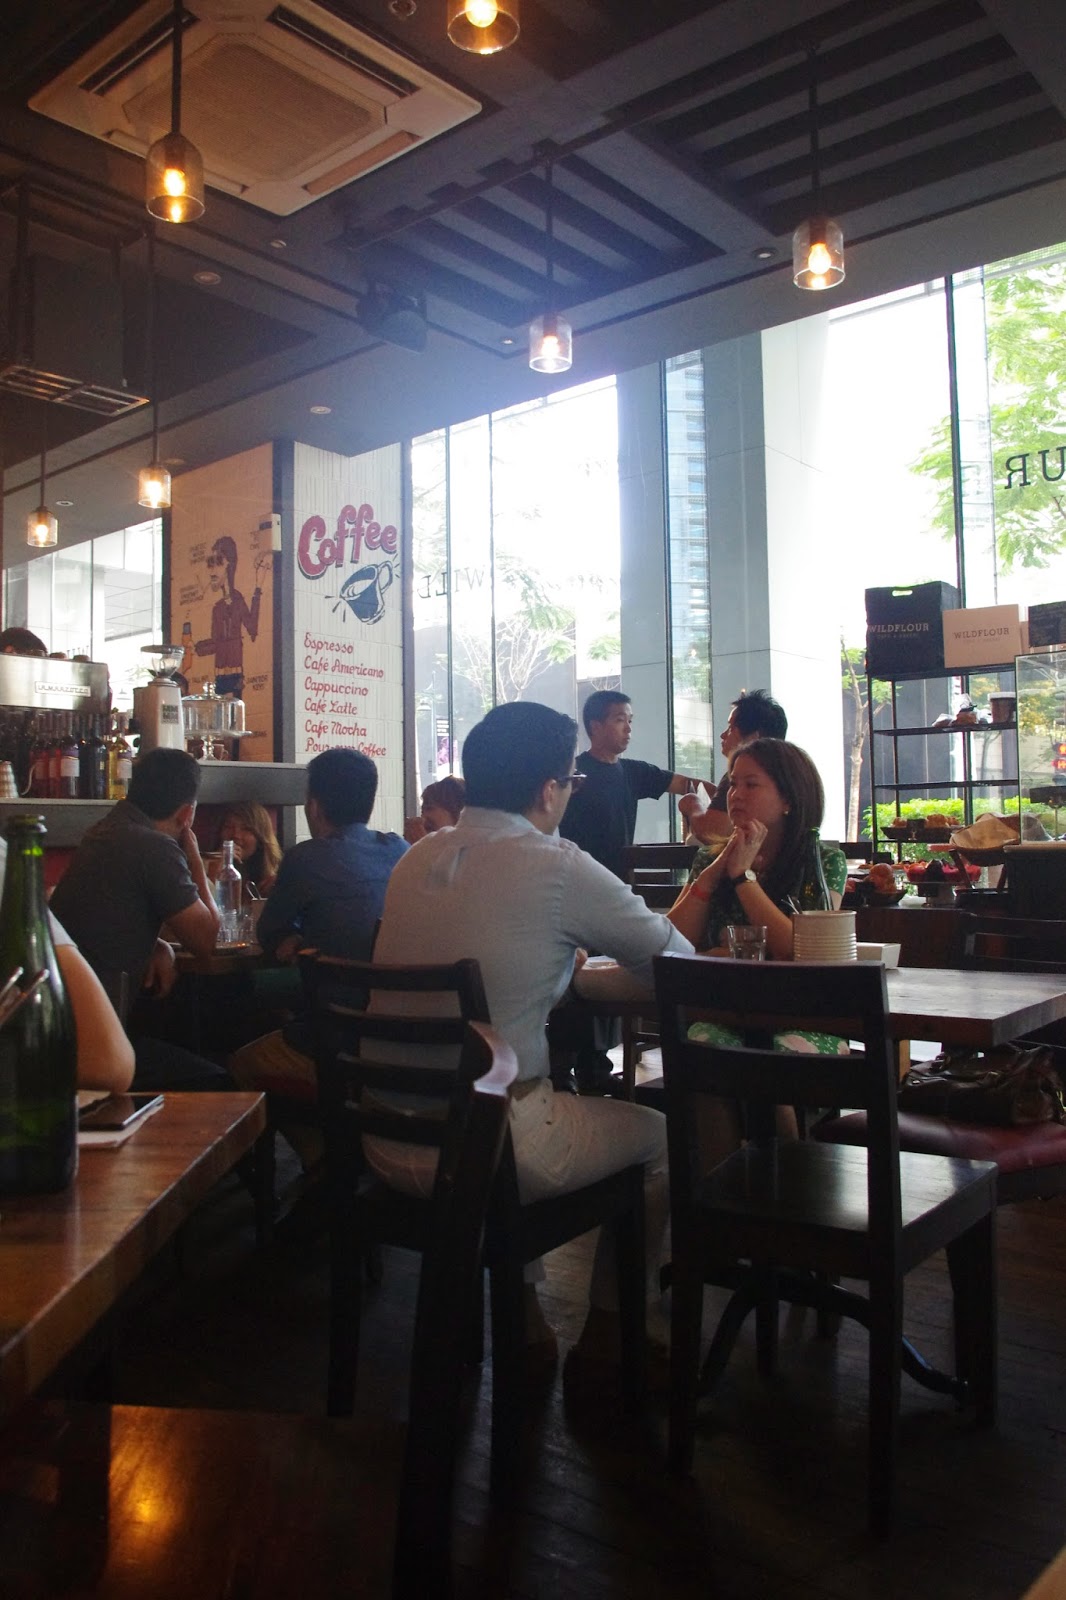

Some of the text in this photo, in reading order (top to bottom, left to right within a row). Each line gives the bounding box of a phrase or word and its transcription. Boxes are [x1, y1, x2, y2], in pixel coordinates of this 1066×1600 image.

[297, 504, 397, 580] Coffee
[869, 622, 929, 633] WILDFLOUR
[952, 627, 1010, 639] WILDFLOUR
[304, 632, 354, 655] Espresso
[304, 655, 384, 678] Café Americano
[304, 676, 369, 698] Cappuccino
[329, 700, 358, 715] Latte
[331, 721, 367, 737] Mocha
